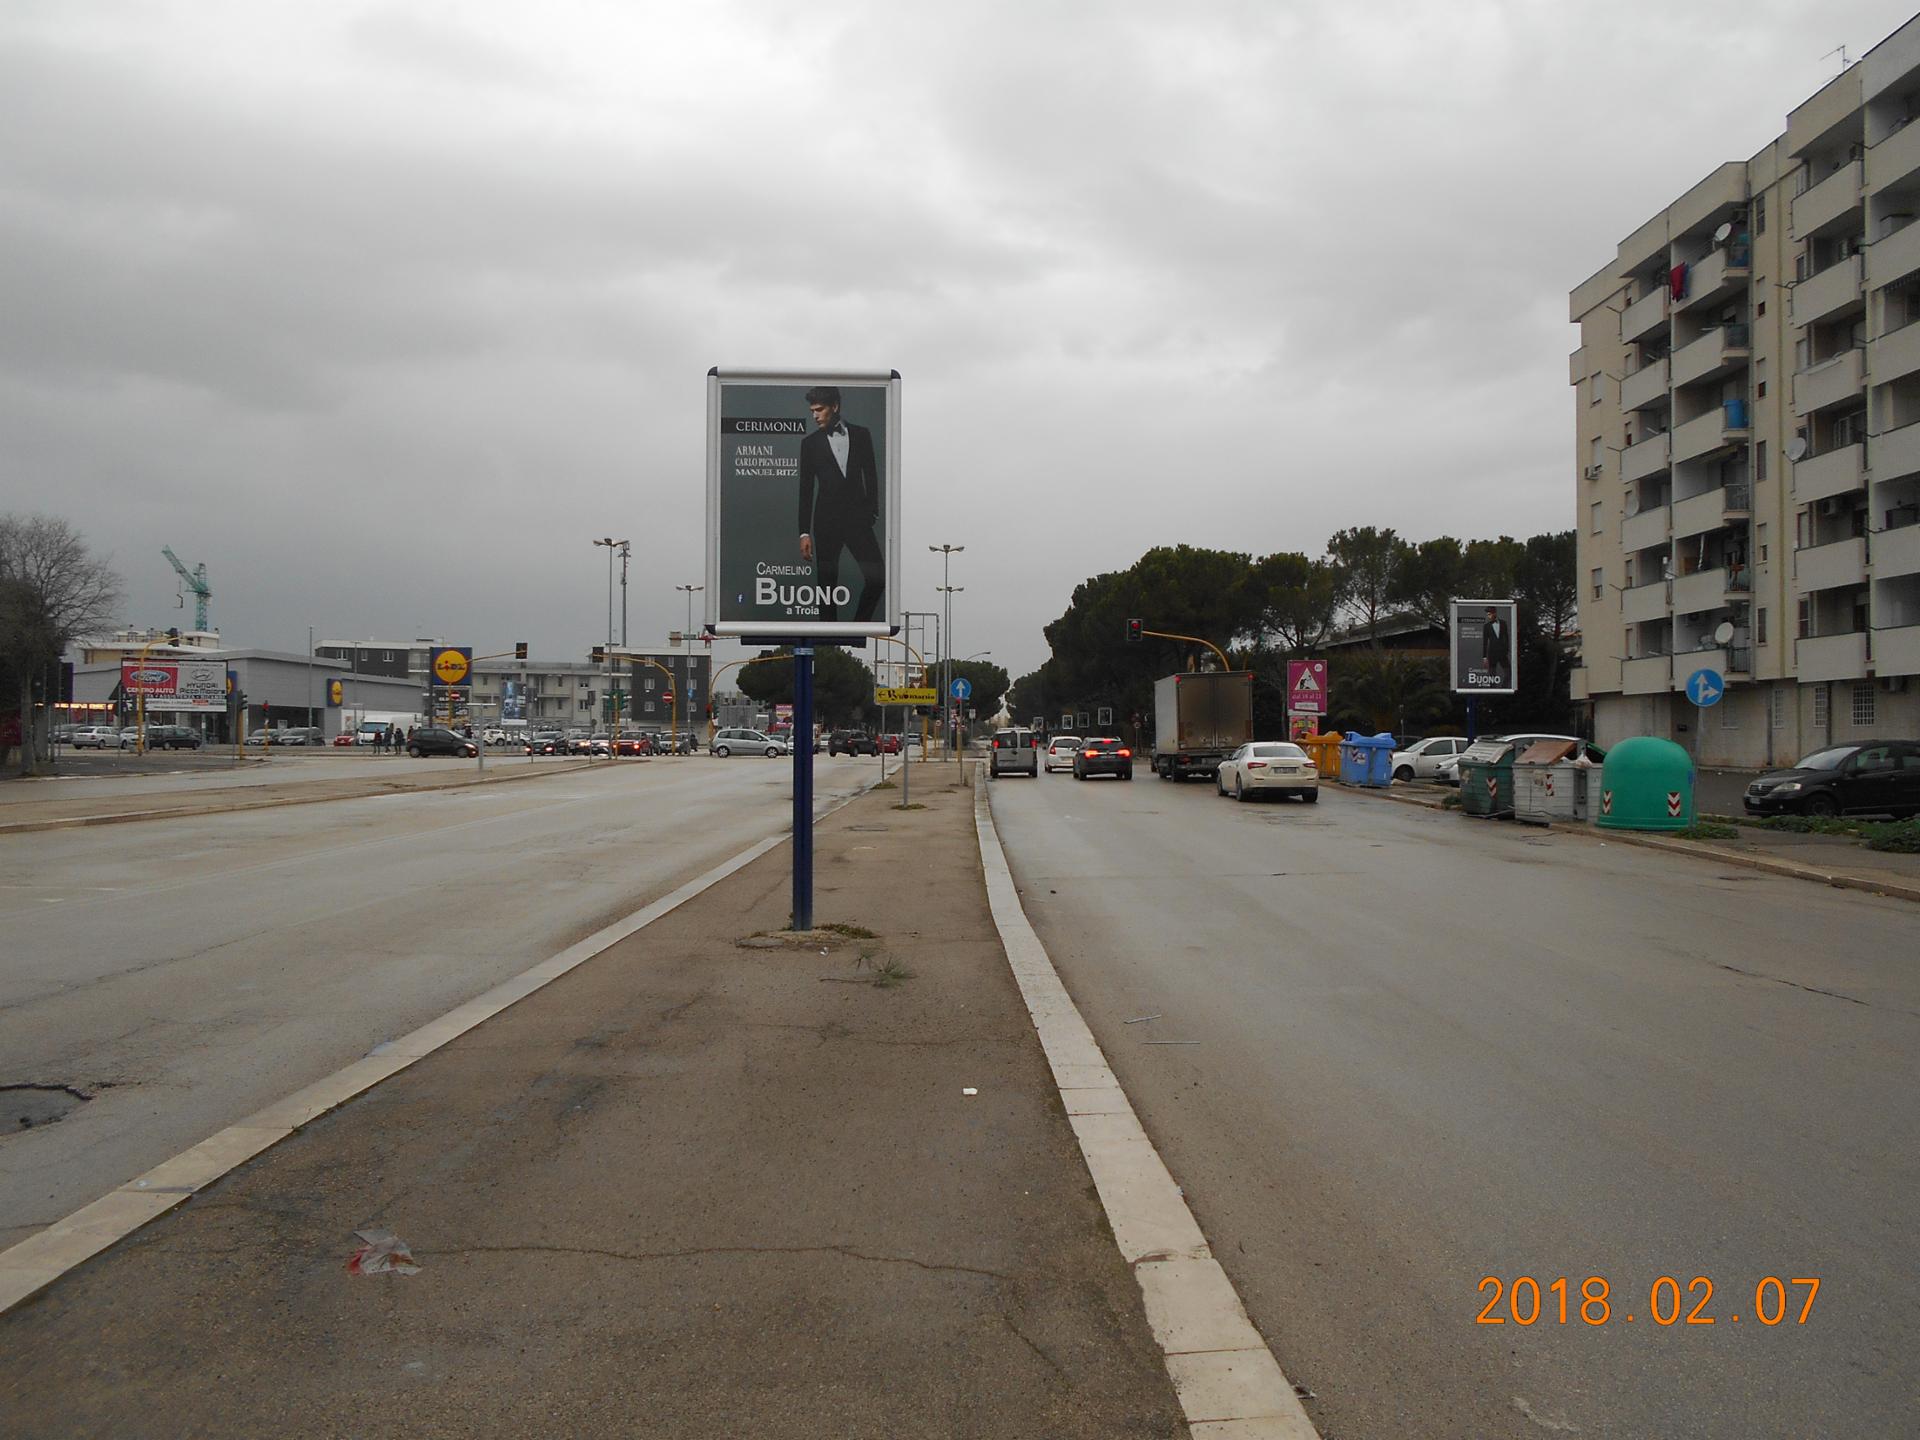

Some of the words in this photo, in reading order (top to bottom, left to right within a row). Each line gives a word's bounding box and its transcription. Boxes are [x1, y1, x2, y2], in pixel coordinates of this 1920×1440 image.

[735, 421, 805, 432] CERIMONIA
[735, 445, 773, 456] ARMANI
[735, 457, 758, 467] CARLO
[758, 457, 798, 467] PIGNATELLI
[735, 468, 775, 476] MANUEL
[776, 468, 798, 476] RITZ
[756, 561, 812, 576] CARMELINO
[755, 577, 850, 606] BUONO
[786, 607, 793, 615] a
[794, 605, 820, 615] Troia
[1468, 673, 1501, 684] BUONO
